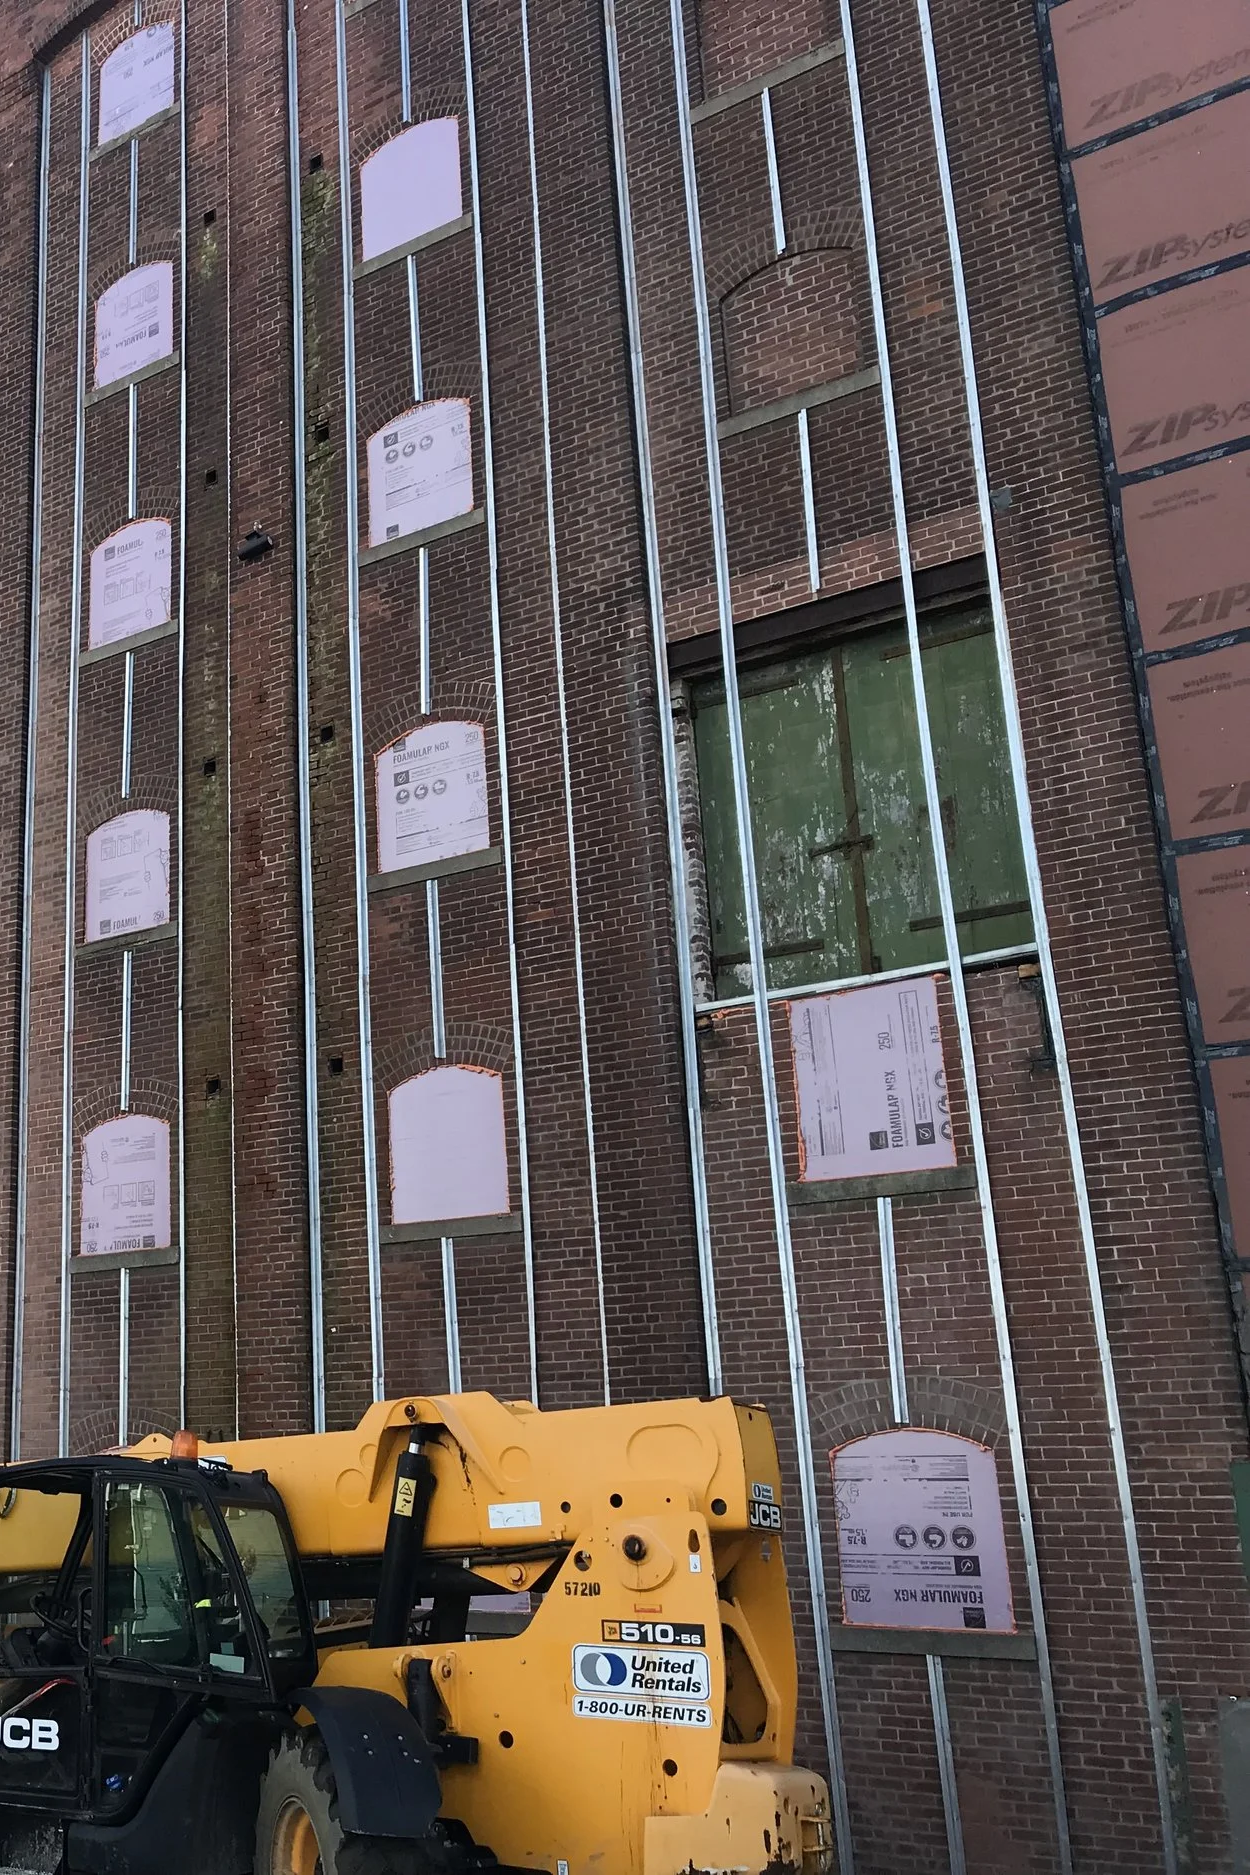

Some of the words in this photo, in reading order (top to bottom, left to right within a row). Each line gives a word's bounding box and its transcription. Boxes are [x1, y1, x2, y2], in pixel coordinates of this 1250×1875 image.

[750, 1503, 781, 1528] JCB
[564, 1581, 601, 1597] 57210
[851, 1588, 871, 1603] 250
[894, 1589, 918, 1602] NGX
[921, 1589, 984, 1604] FOAMULAR
[631, 1655, 695, 1675] United
[631, 1673, 702, 1693] Rentals
[576, 1700, 707, 1723] 1-800-UR-RENTS
